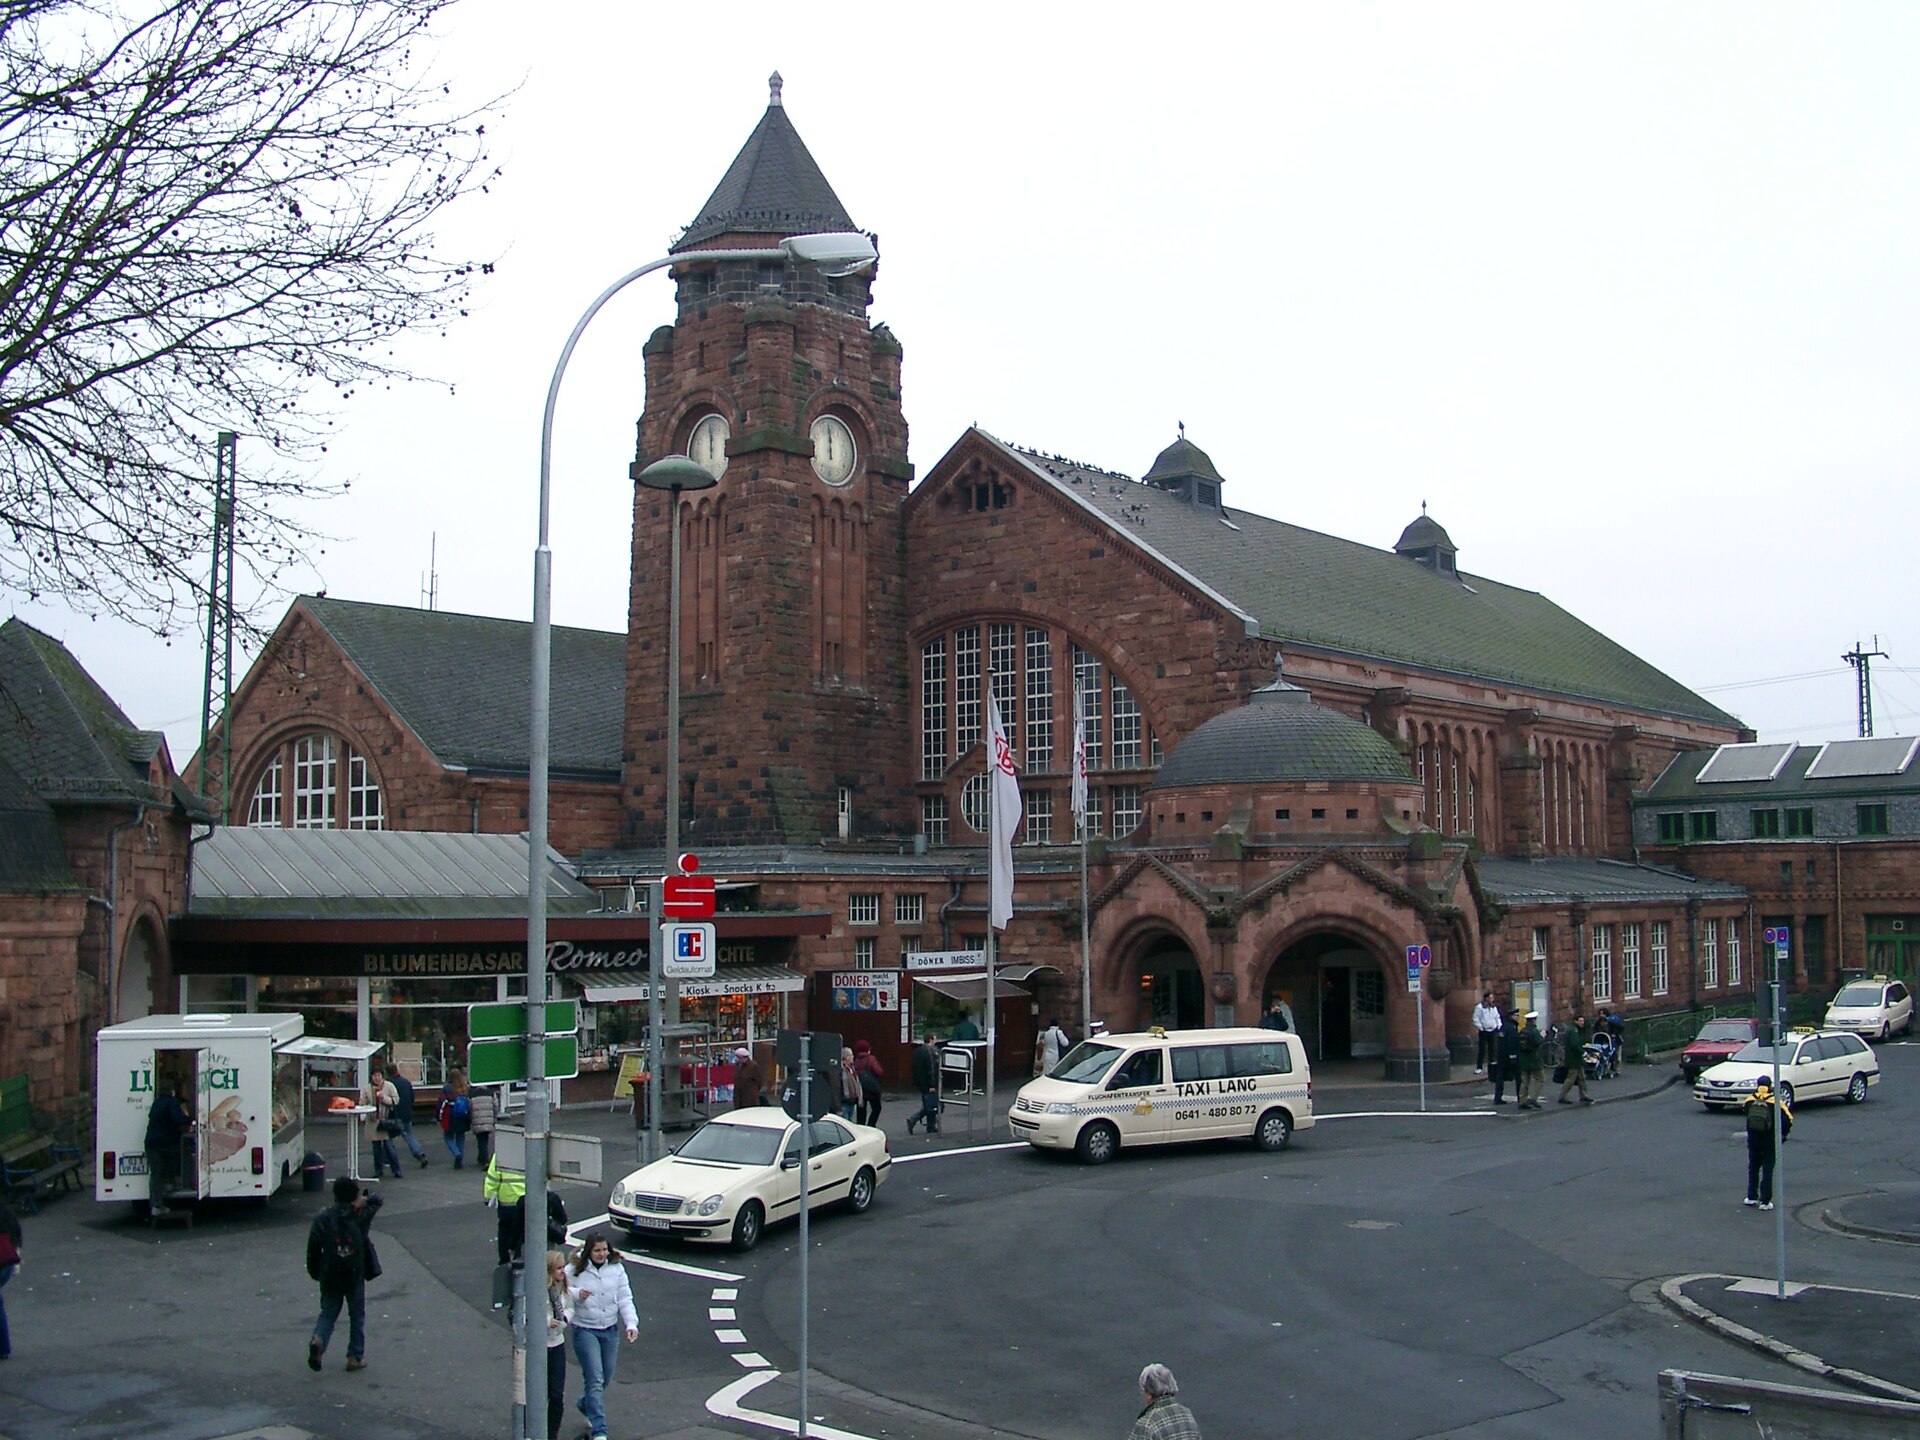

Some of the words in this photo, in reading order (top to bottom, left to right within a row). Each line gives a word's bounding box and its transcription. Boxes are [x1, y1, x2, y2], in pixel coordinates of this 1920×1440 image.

[364, 952, 523, 972] BLUMENBASAR
[546, 941, 648, 971] Romeo
[918, 958, 944, 966] DÖNER
[951, 954, 975, 965] IMBISS
[666, 965, 713, 974] Geldautomat
[834, 974, 870, 986] DÖNER
[686, 986, 710, 996] Kiosk
[724, 983, 753, 994] Snacks
[1175, 1082, 1210, 1097] TAXI
[1219, 1078, 1257, 1094] LANG
[1088, 1090, 1151, 1101] FLUGHAFENTRANSFER
[1175, 1110, 1200, 1121] 0641
[1208, 1107, 1228, 1118] 480
[1229, 1106, 1242, 1116] 80
[1244, 1104, 1257, 1115] 72
